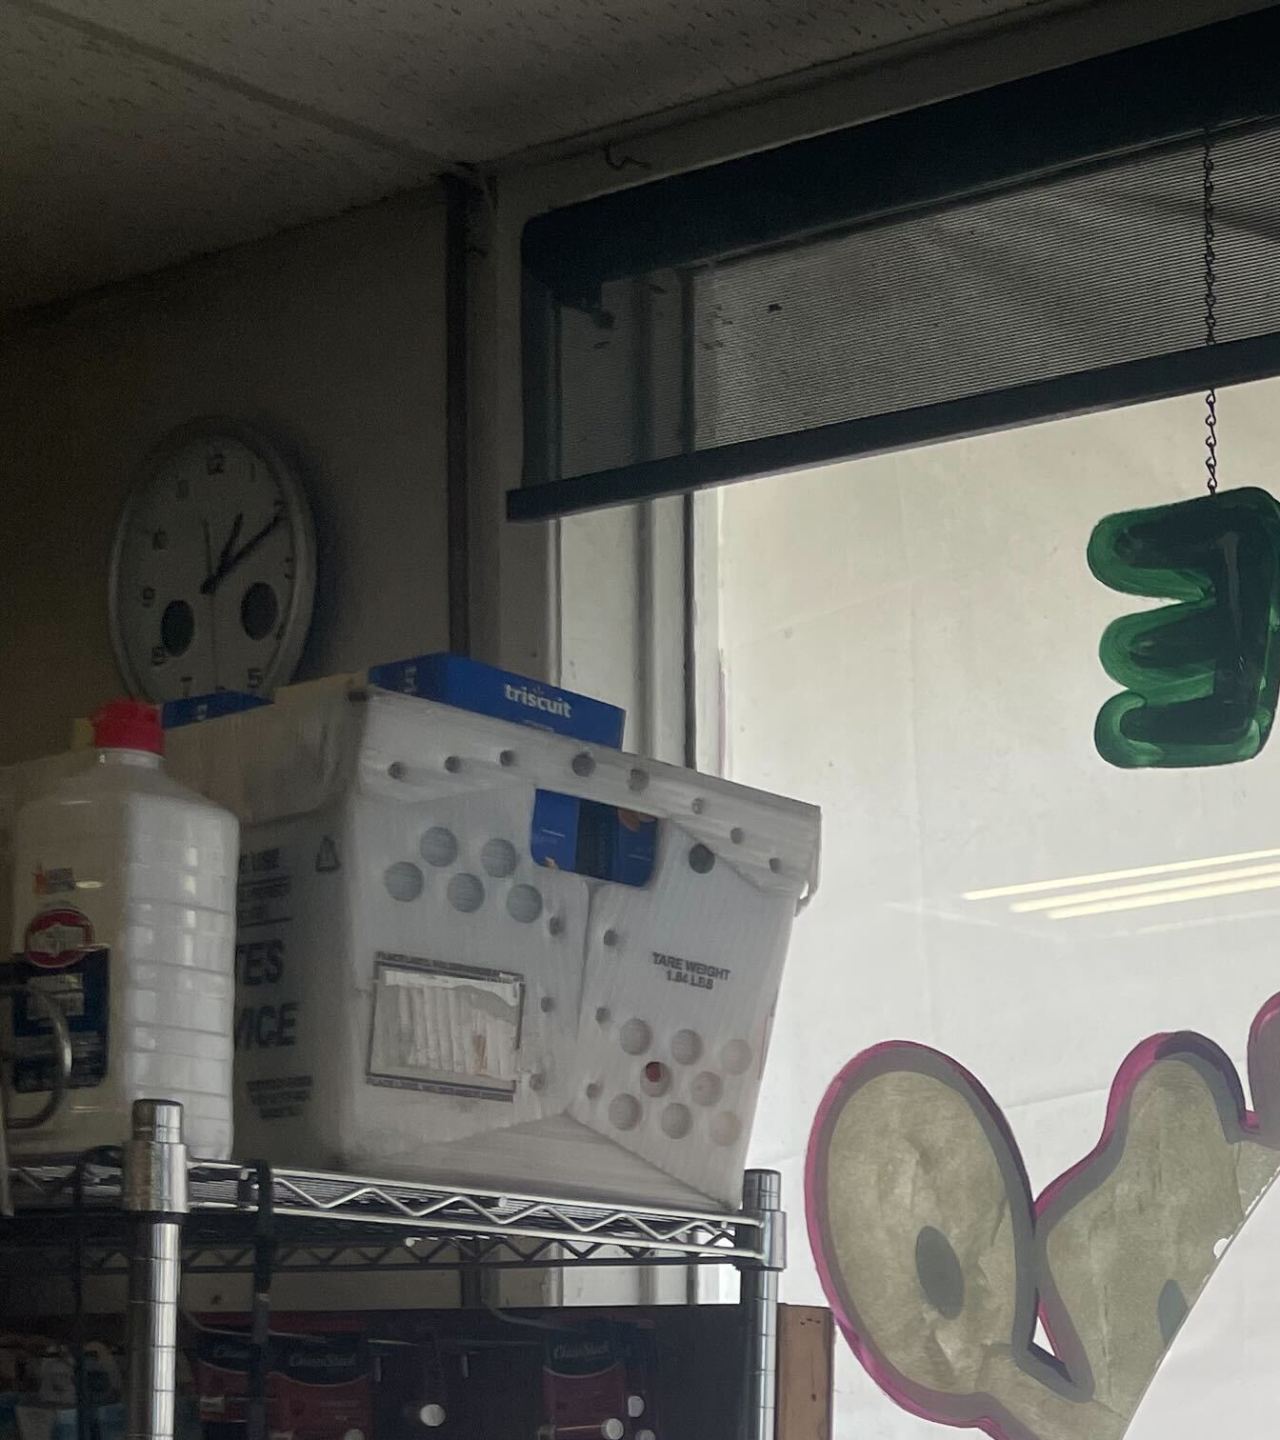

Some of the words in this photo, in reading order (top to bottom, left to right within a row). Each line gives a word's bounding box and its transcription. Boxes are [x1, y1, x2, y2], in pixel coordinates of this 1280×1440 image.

[503, 682, 573, 720] triscuit
[651, 951, 684, 971] TARE
[685, 960, 731, 981] WEIGHT
